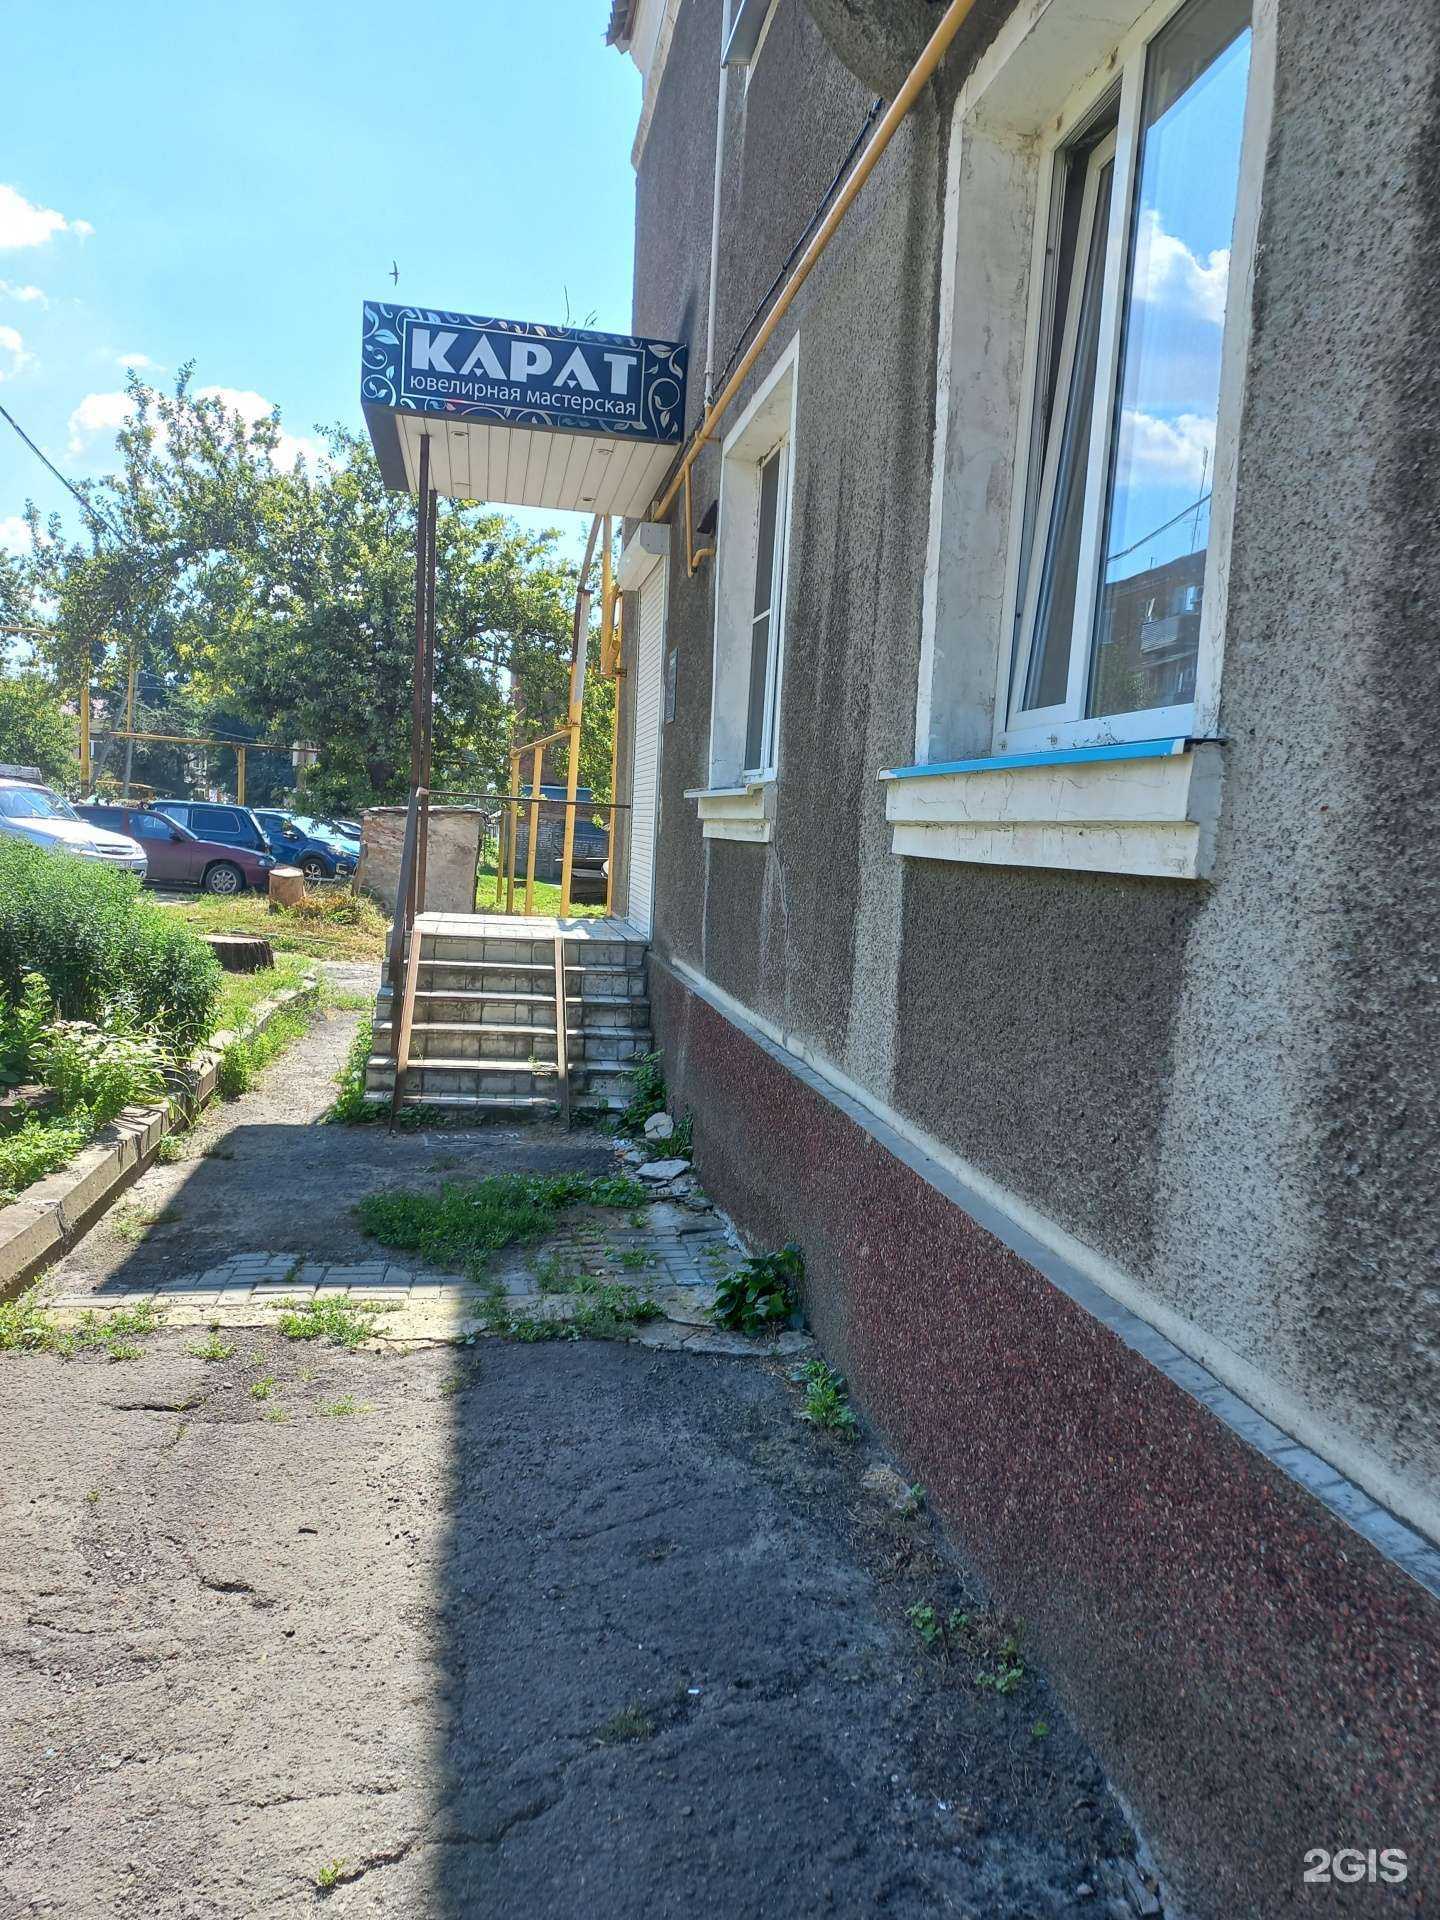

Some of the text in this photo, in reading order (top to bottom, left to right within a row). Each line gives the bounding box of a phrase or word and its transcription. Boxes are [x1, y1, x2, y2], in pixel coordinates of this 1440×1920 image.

[412, 328, 637, 395] КАРАТ
[410, 375, 636, 415] ювелирная мастерская
